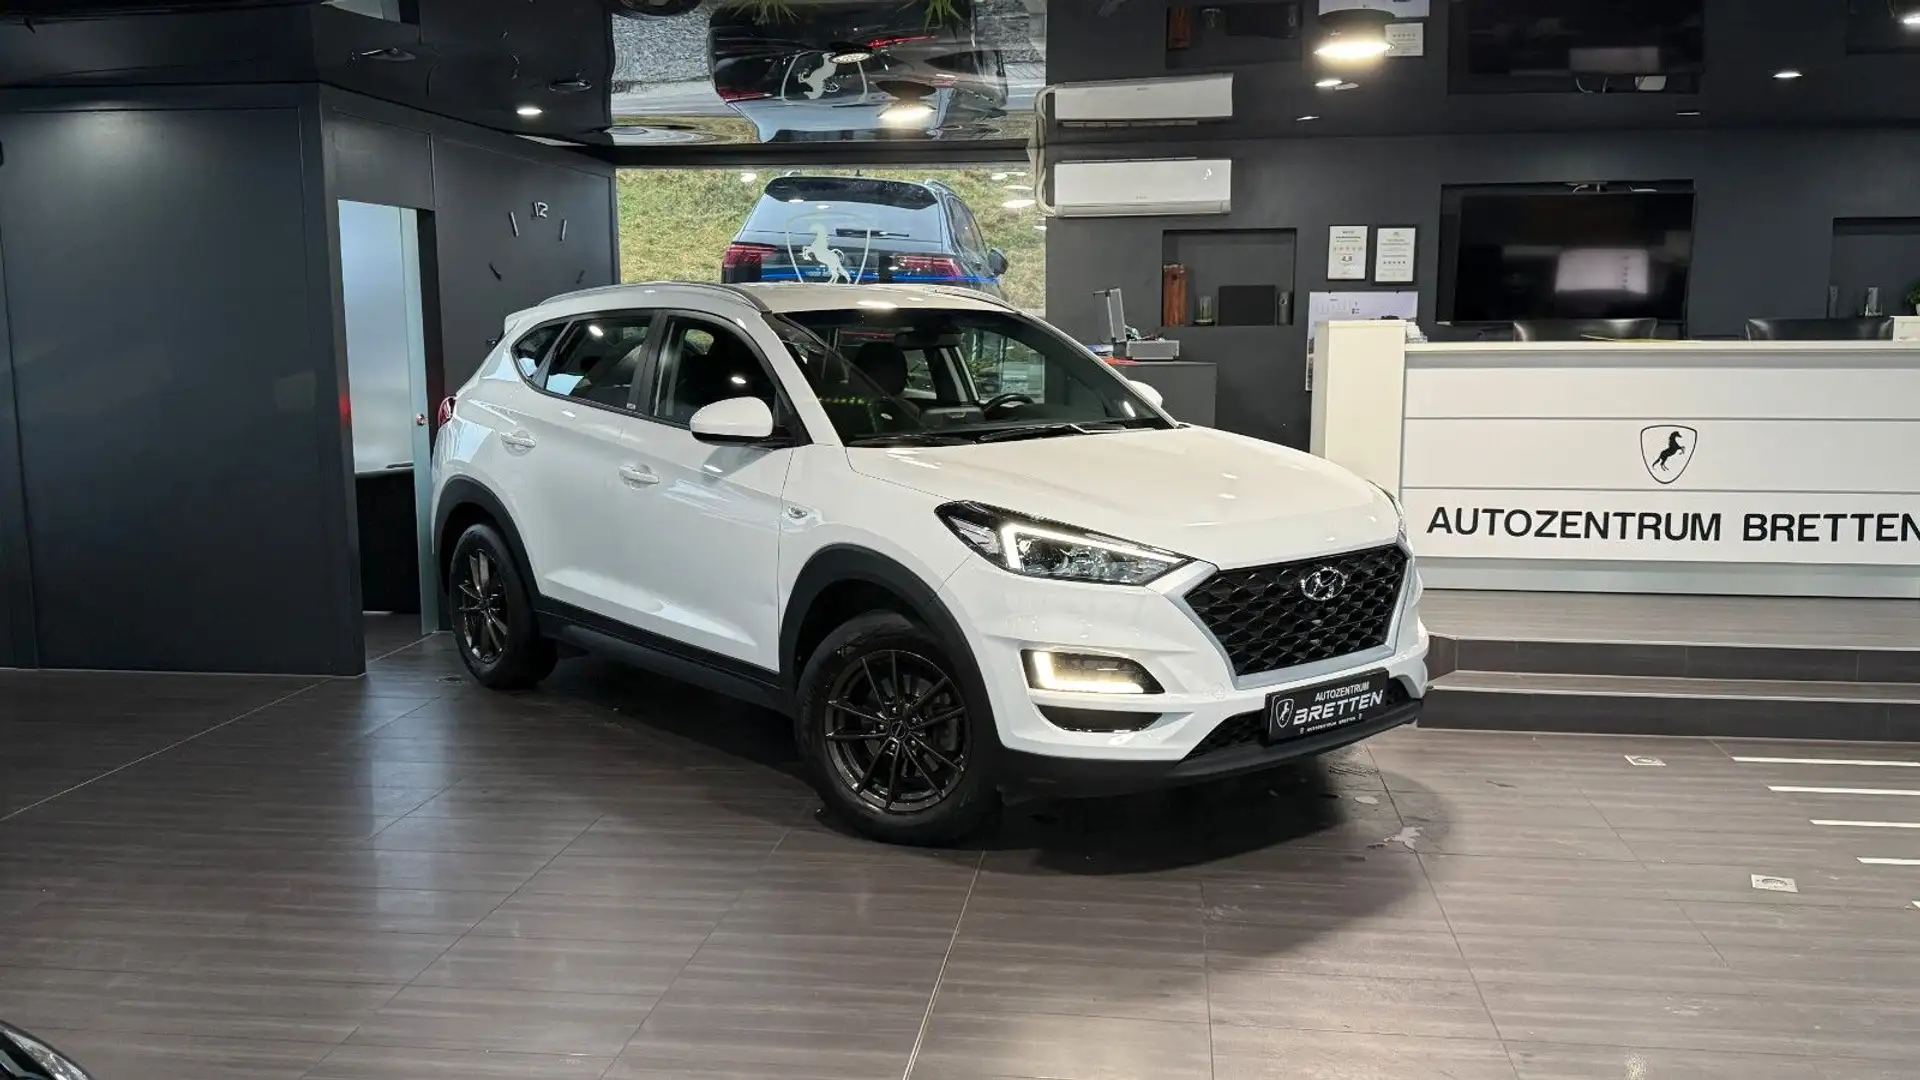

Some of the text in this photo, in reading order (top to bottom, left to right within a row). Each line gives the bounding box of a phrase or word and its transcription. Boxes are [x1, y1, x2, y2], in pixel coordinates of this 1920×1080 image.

[1426, 506, 1721, 542] AUTOZENTRUM
[1293, 689, 1384, 726] BRETTEN
[1314, 681, 1370, 702] AUTOZENTRUM
